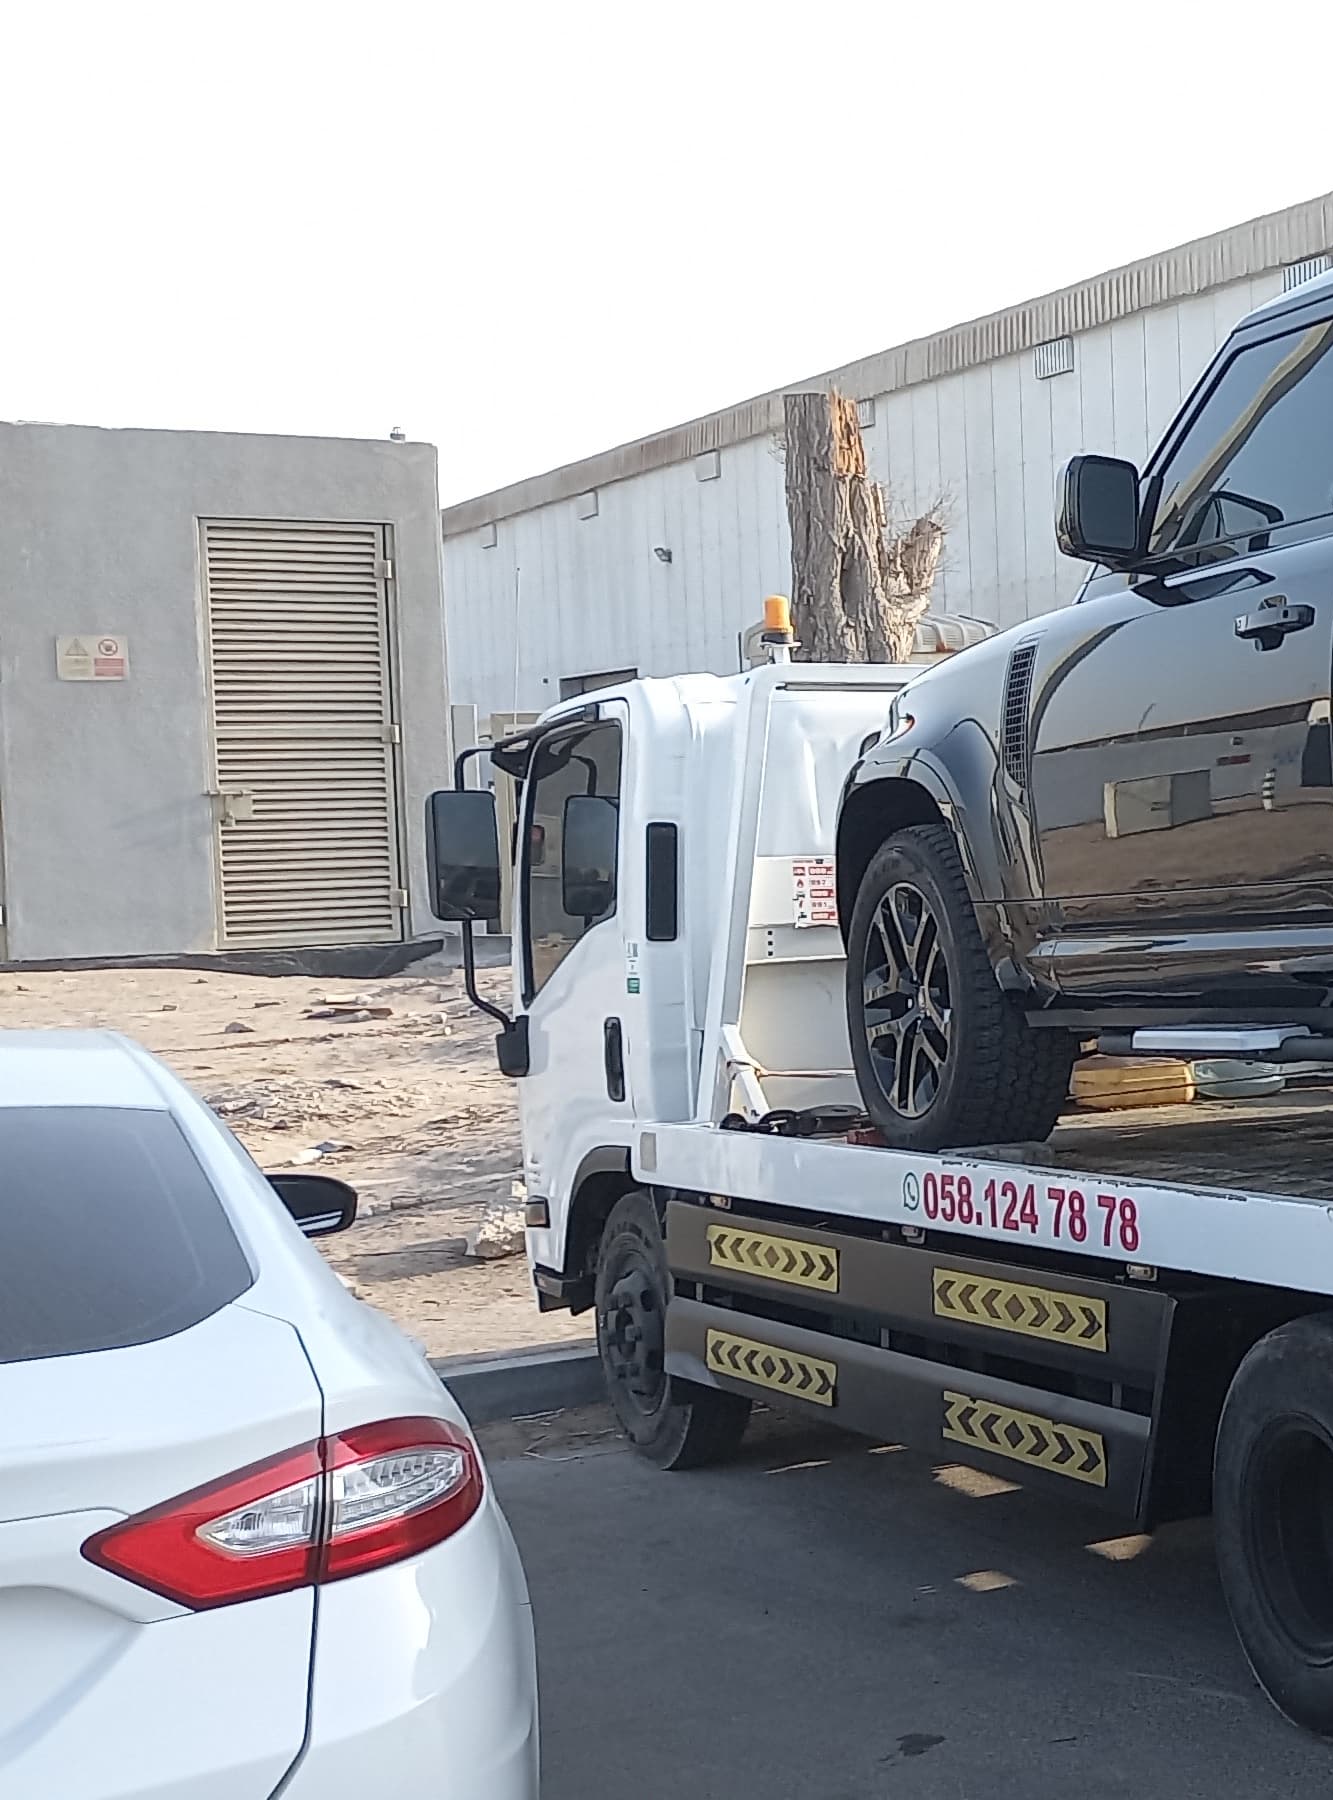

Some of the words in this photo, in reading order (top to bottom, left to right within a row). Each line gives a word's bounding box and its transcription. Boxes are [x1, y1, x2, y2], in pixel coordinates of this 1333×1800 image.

[923, 1171, 1039, 1235] 058.124
[1047, 1186, 1088, 1243] 78
[1096, 1193, 1140, 1252] 78
